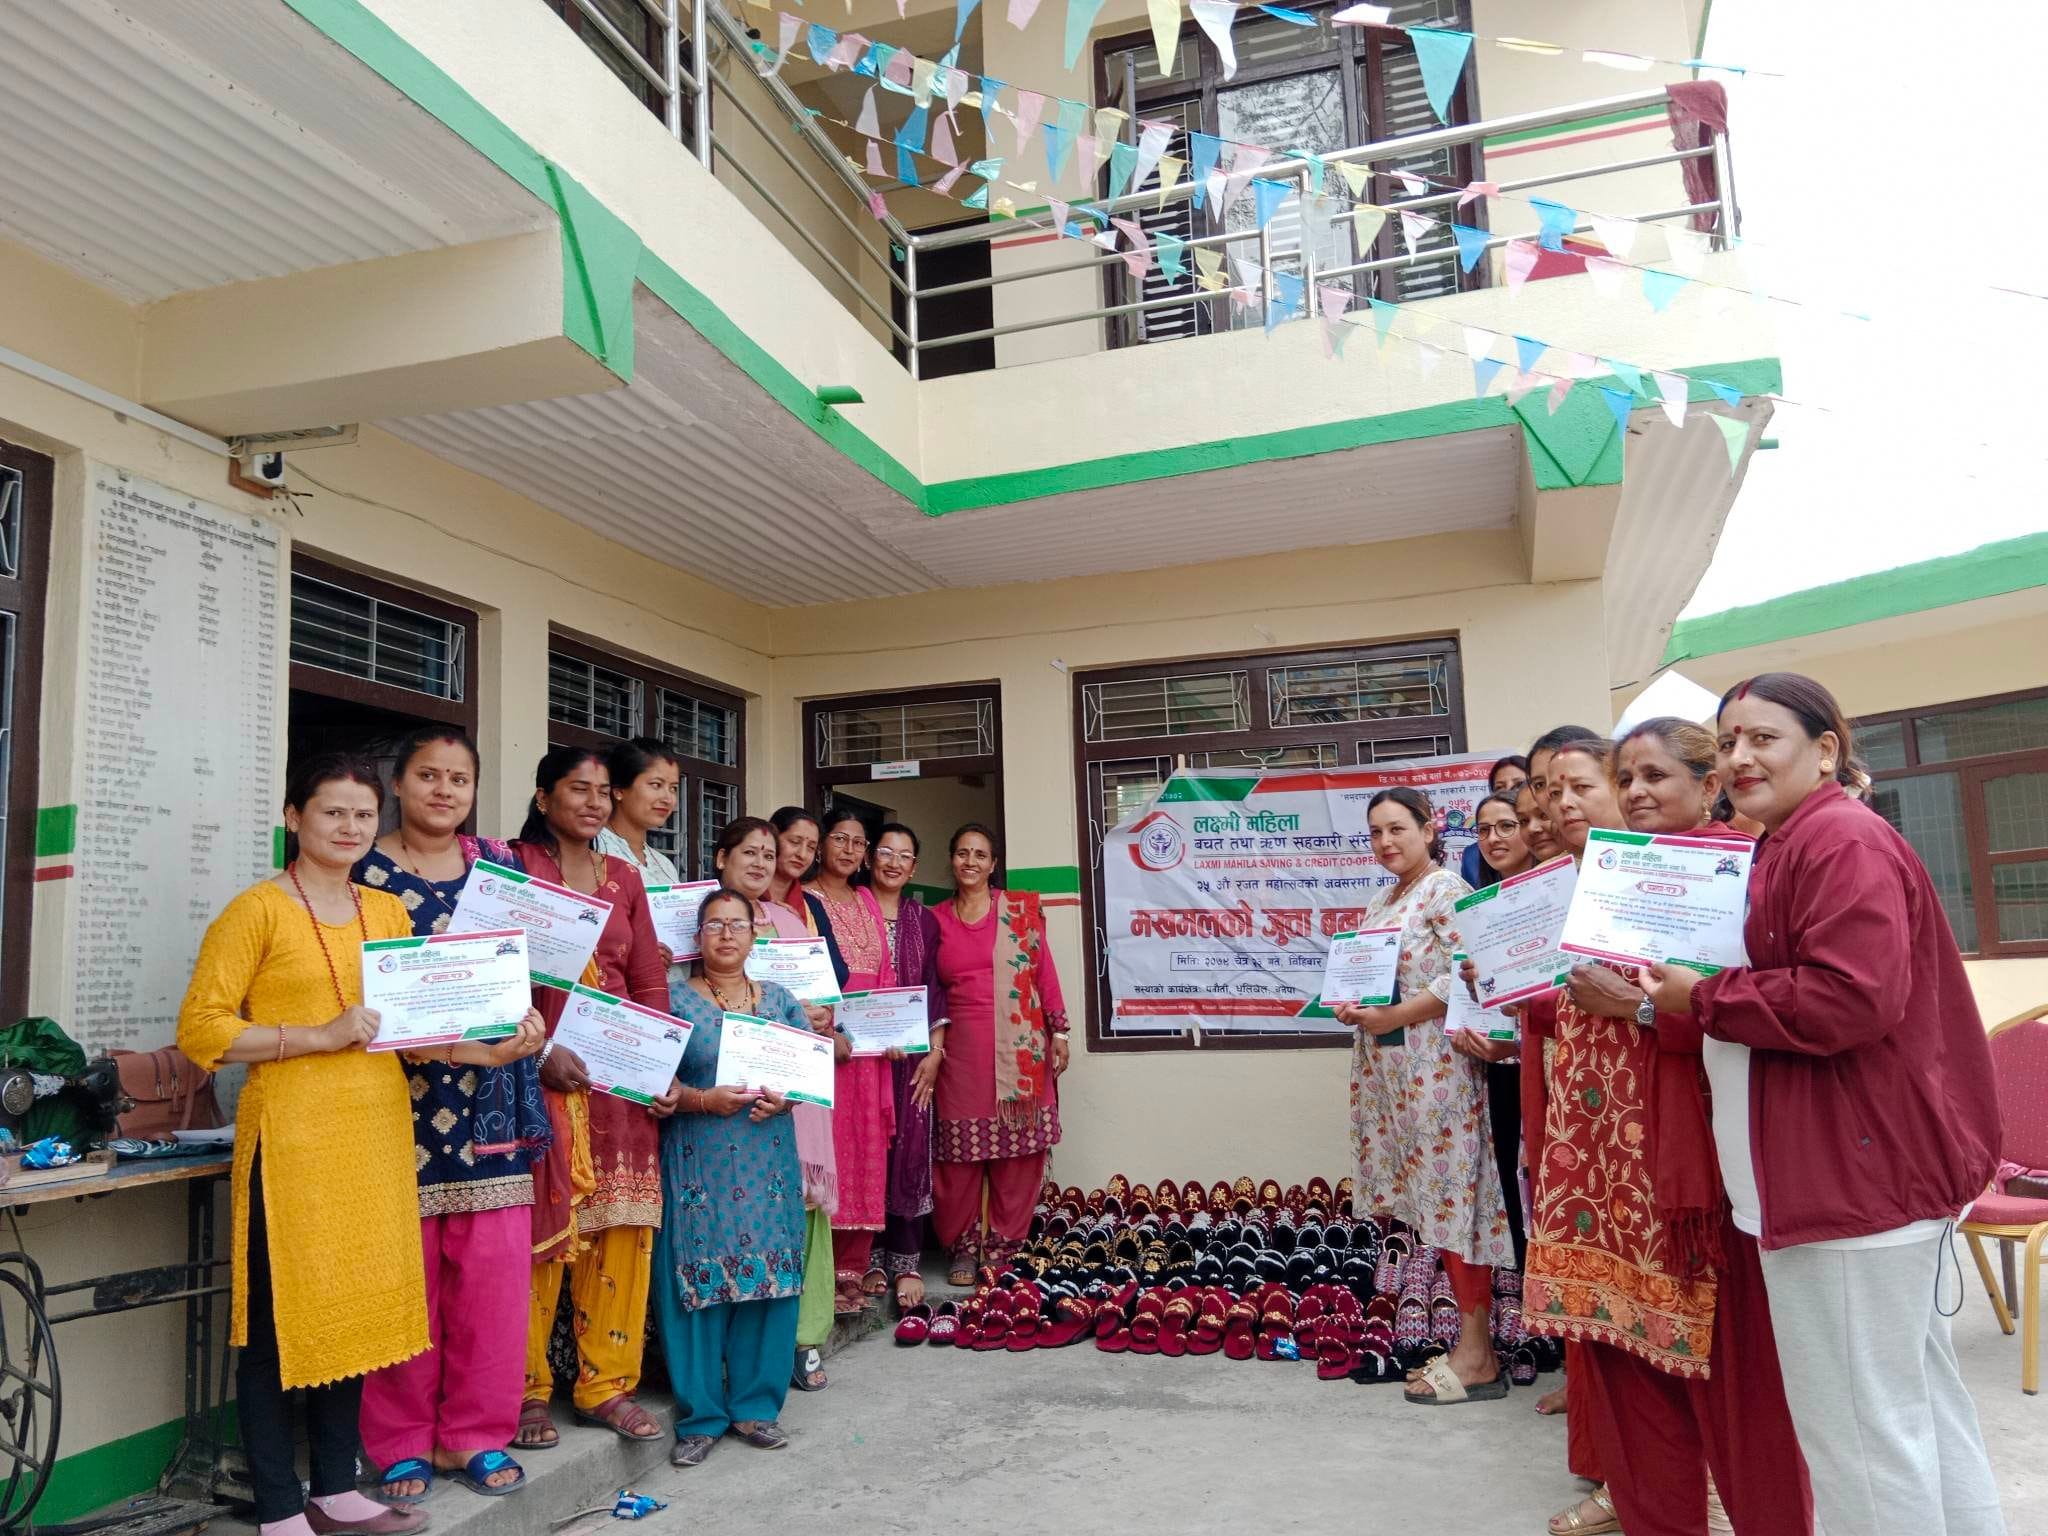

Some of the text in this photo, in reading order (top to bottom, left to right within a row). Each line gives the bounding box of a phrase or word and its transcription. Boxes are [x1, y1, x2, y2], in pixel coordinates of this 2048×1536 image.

[1194, 808, 1301, 835] लक्ष्मी महिला
[1194, 837, 1224, 850] बचत
[1230, 837, 1255, 850] तथा
[1260, 836, 1289, 850] ऋण
[1293, 831, 1342, 851] सहकारी
[1194, 859, 1221, 870] LAXMI
[1224, 858, 1257, 869] MAHILA
[1260, 858, 1293, 869] SAVING
[1296, 857, 1303, 869] &
[1305, 857, 1338, 868] CREDIT
[1197, 880, 1211, 893] २५
[1236, 879, 1260, 892] रजत
[1324, 876, 1371, 890] अवसरमा
[1130, 899, 1254, 940] मखमलको
